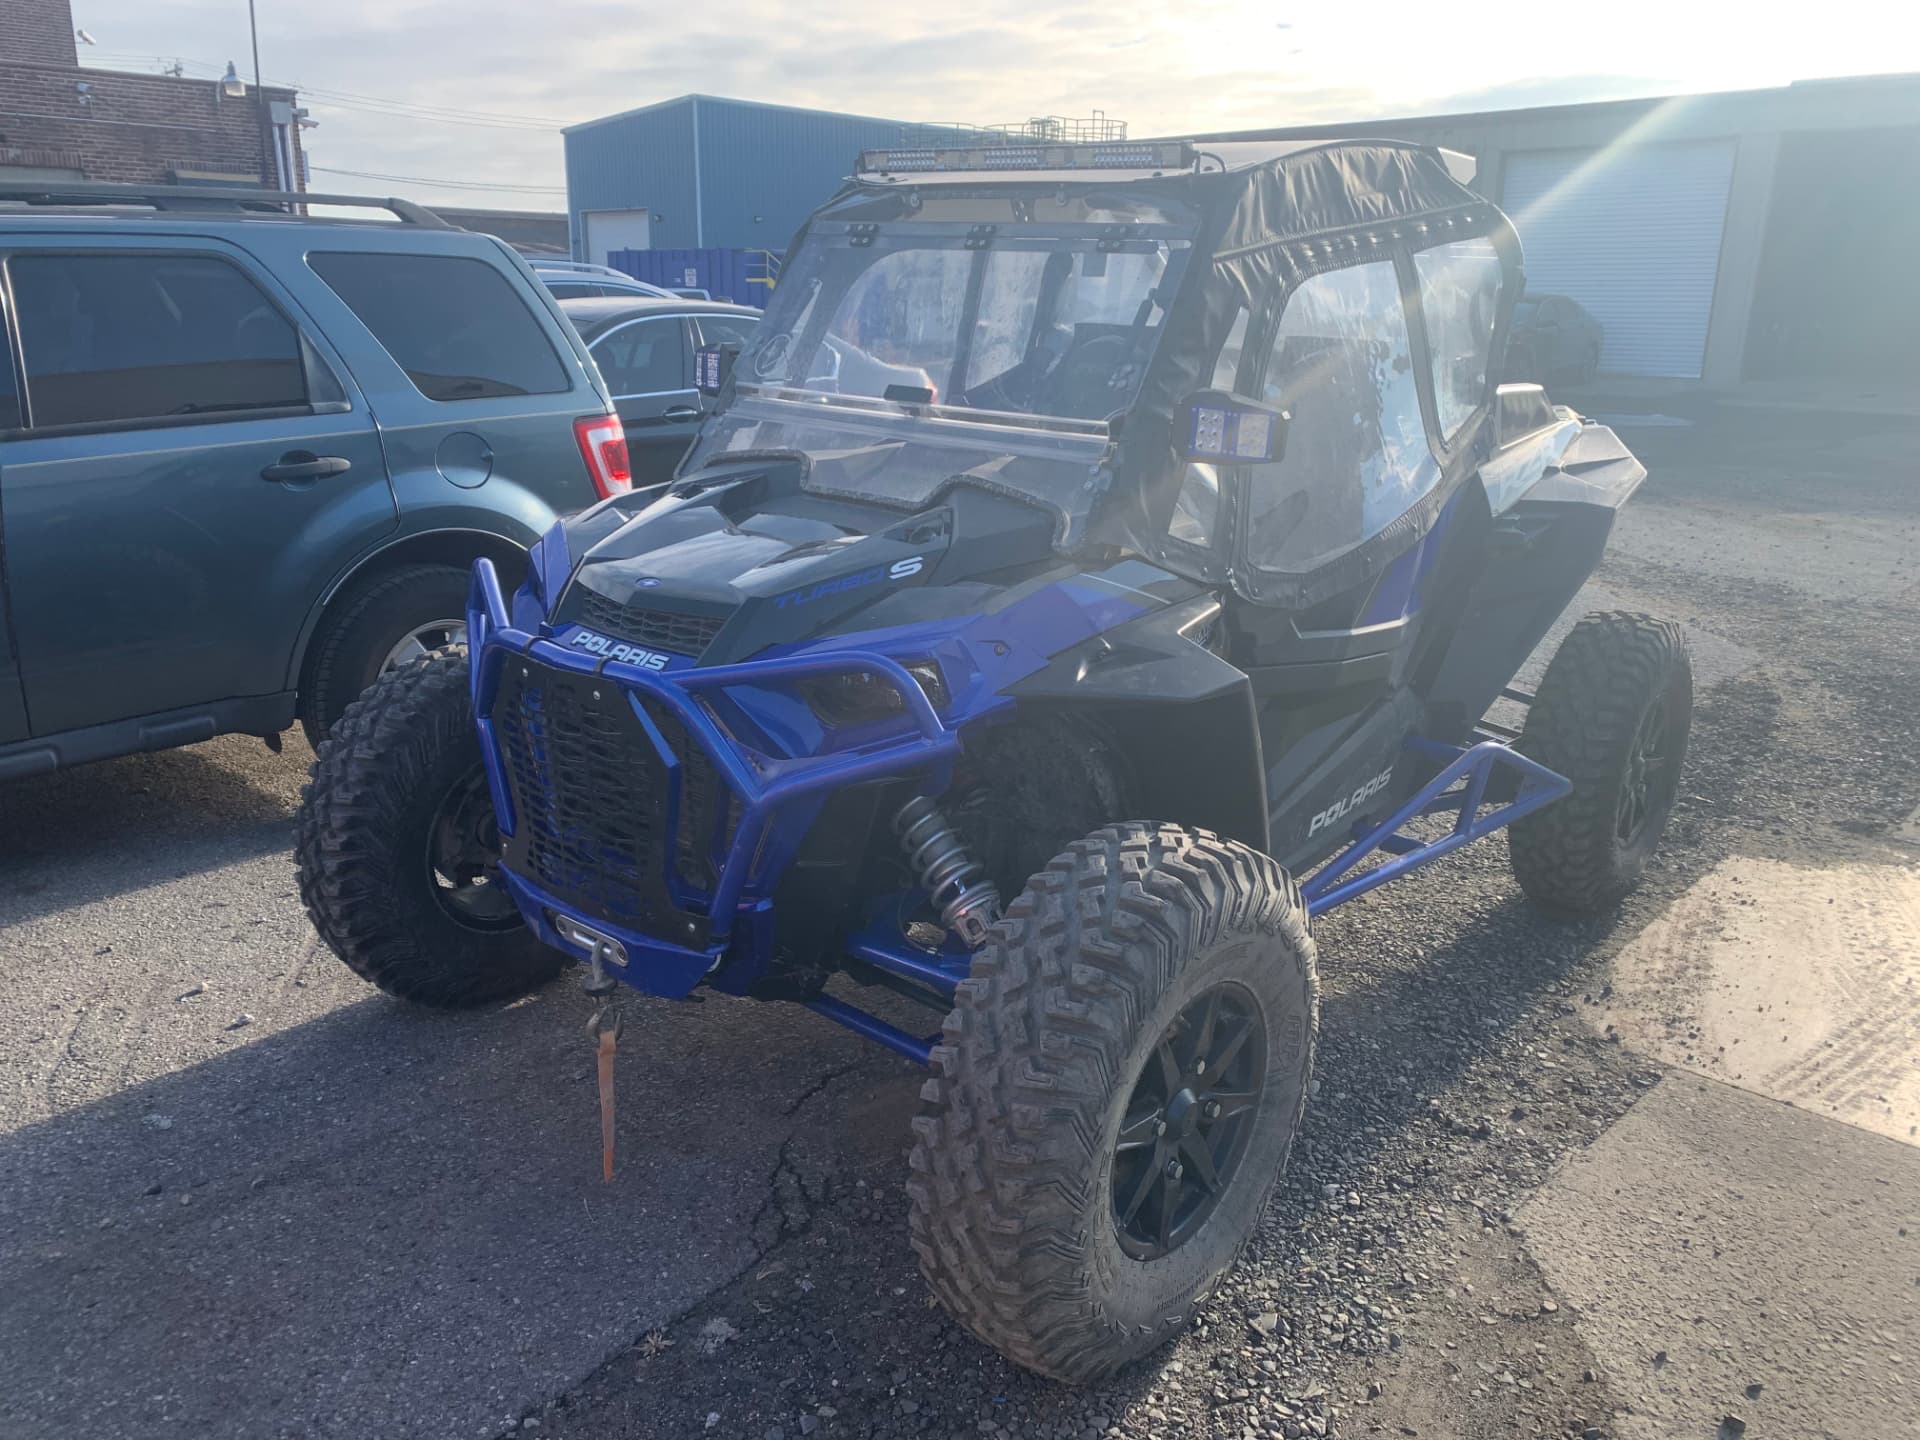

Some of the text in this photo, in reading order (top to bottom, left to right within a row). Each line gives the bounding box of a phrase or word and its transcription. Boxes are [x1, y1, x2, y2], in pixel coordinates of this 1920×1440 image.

[775, 556, 923, 608] TURBO S
[571, 631, 670, 671] POLARIS
[1308, 766, 1393, 838] POLARIS
